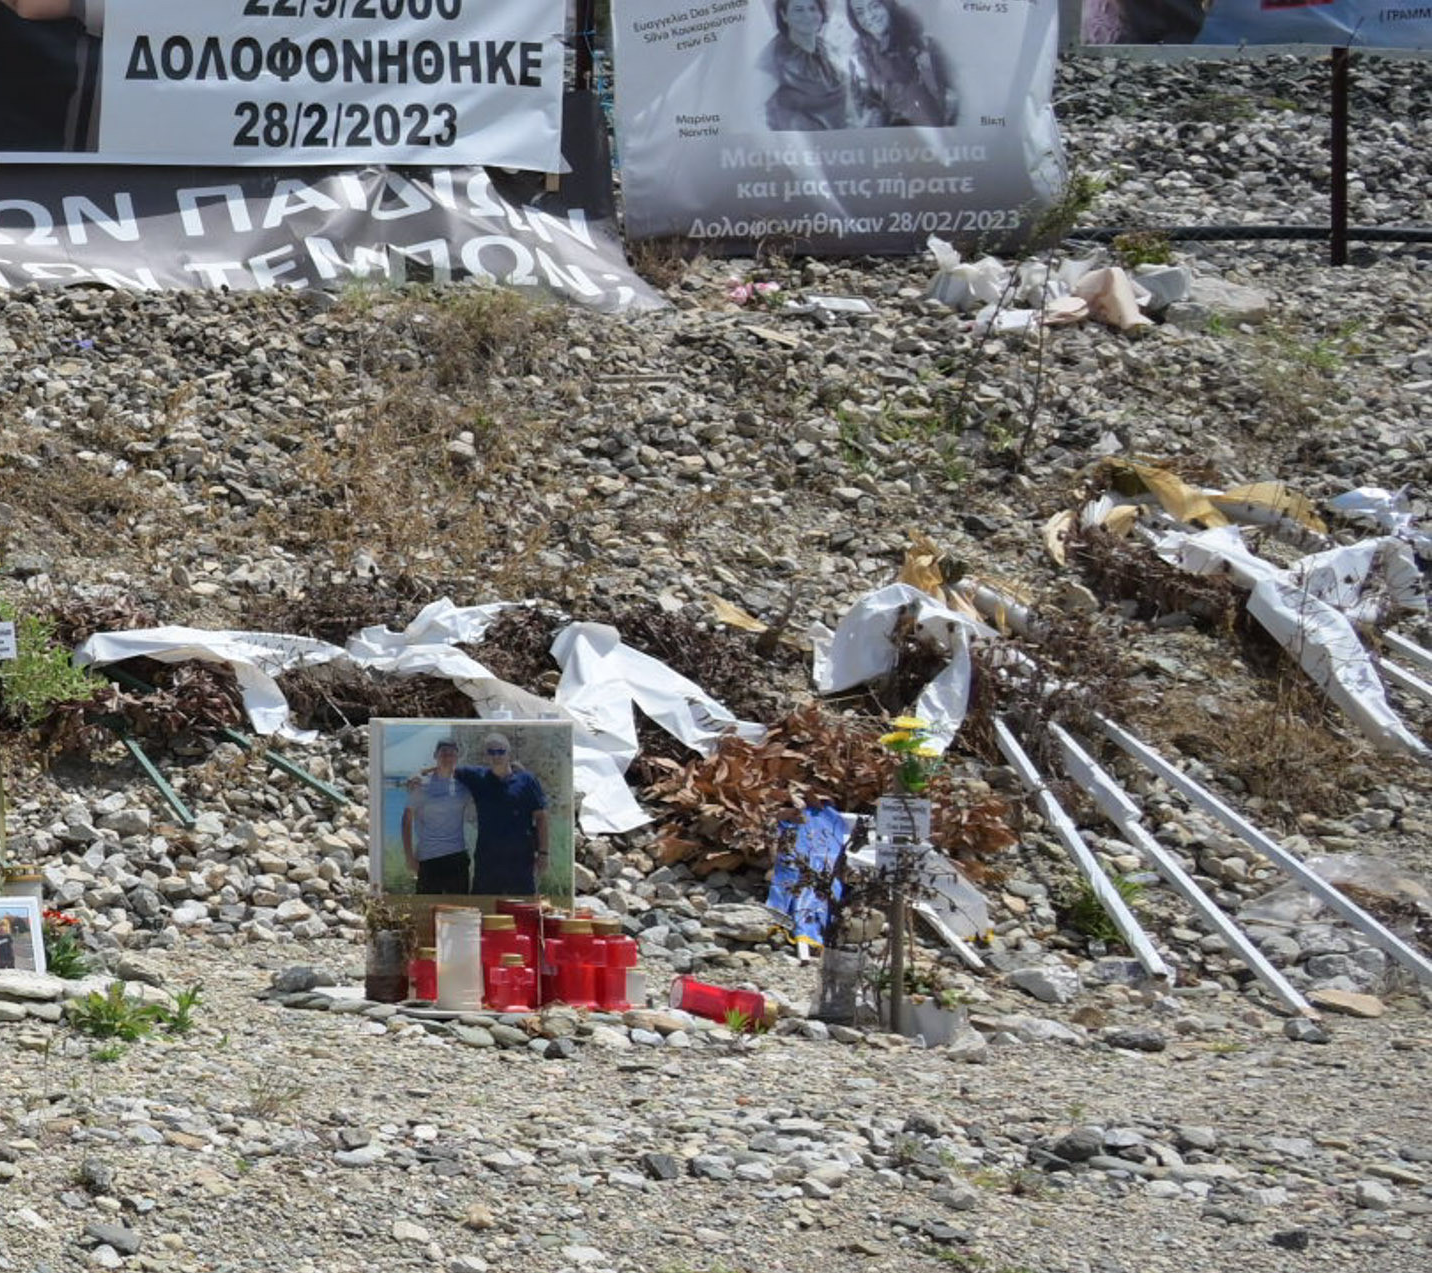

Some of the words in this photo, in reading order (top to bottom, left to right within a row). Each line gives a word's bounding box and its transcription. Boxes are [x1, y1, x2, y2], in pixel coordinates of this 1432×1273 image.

[125, 35, 543, 88] ΔΟΛΟΦΟΝΗΘΗΚΕ
[233, 101, 459, 149] 28/2/2023
[736, 177, 777, 199] και
